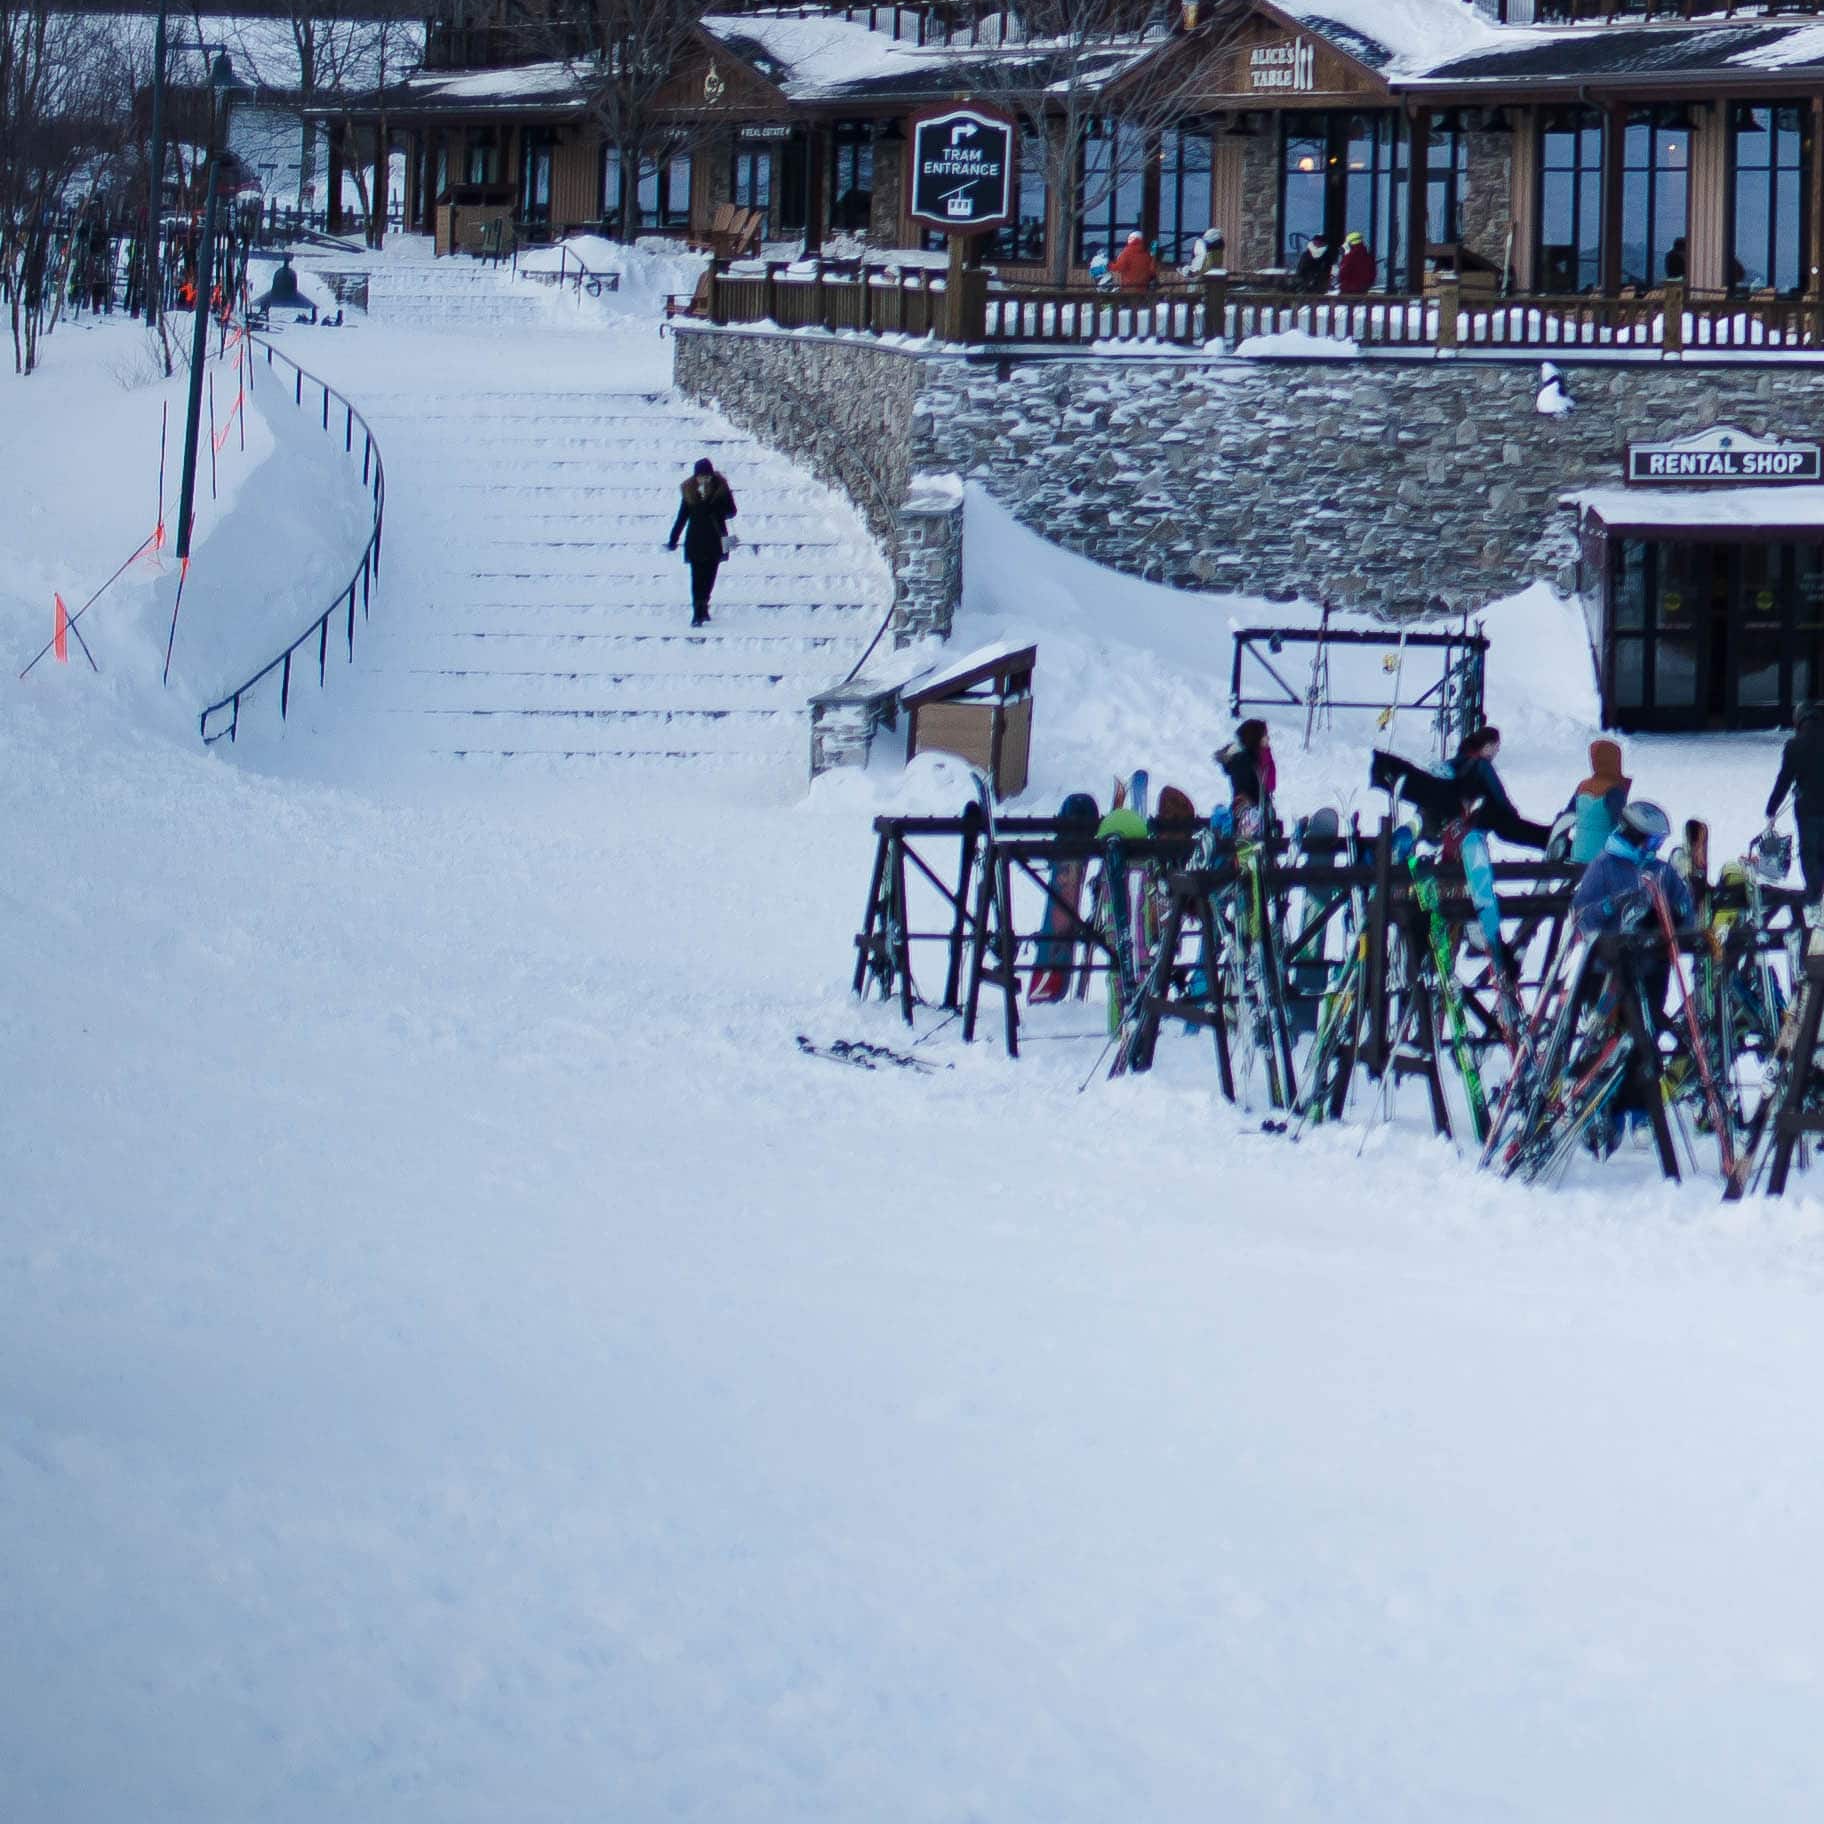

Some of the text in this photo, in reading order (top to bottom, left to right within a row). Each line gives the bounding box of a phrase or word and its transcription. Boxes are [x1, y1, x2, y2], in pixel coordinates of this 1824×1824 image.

[1250, 42, 1295, 65] ALICE'S
[1251, 70, 1293, 87] TABLE
[942, 149, 982, 161] TRAM
[923, 162, 1000, 176] ENTRANCE
[1650, 454, 1803, 474] RENTAL SHOP
